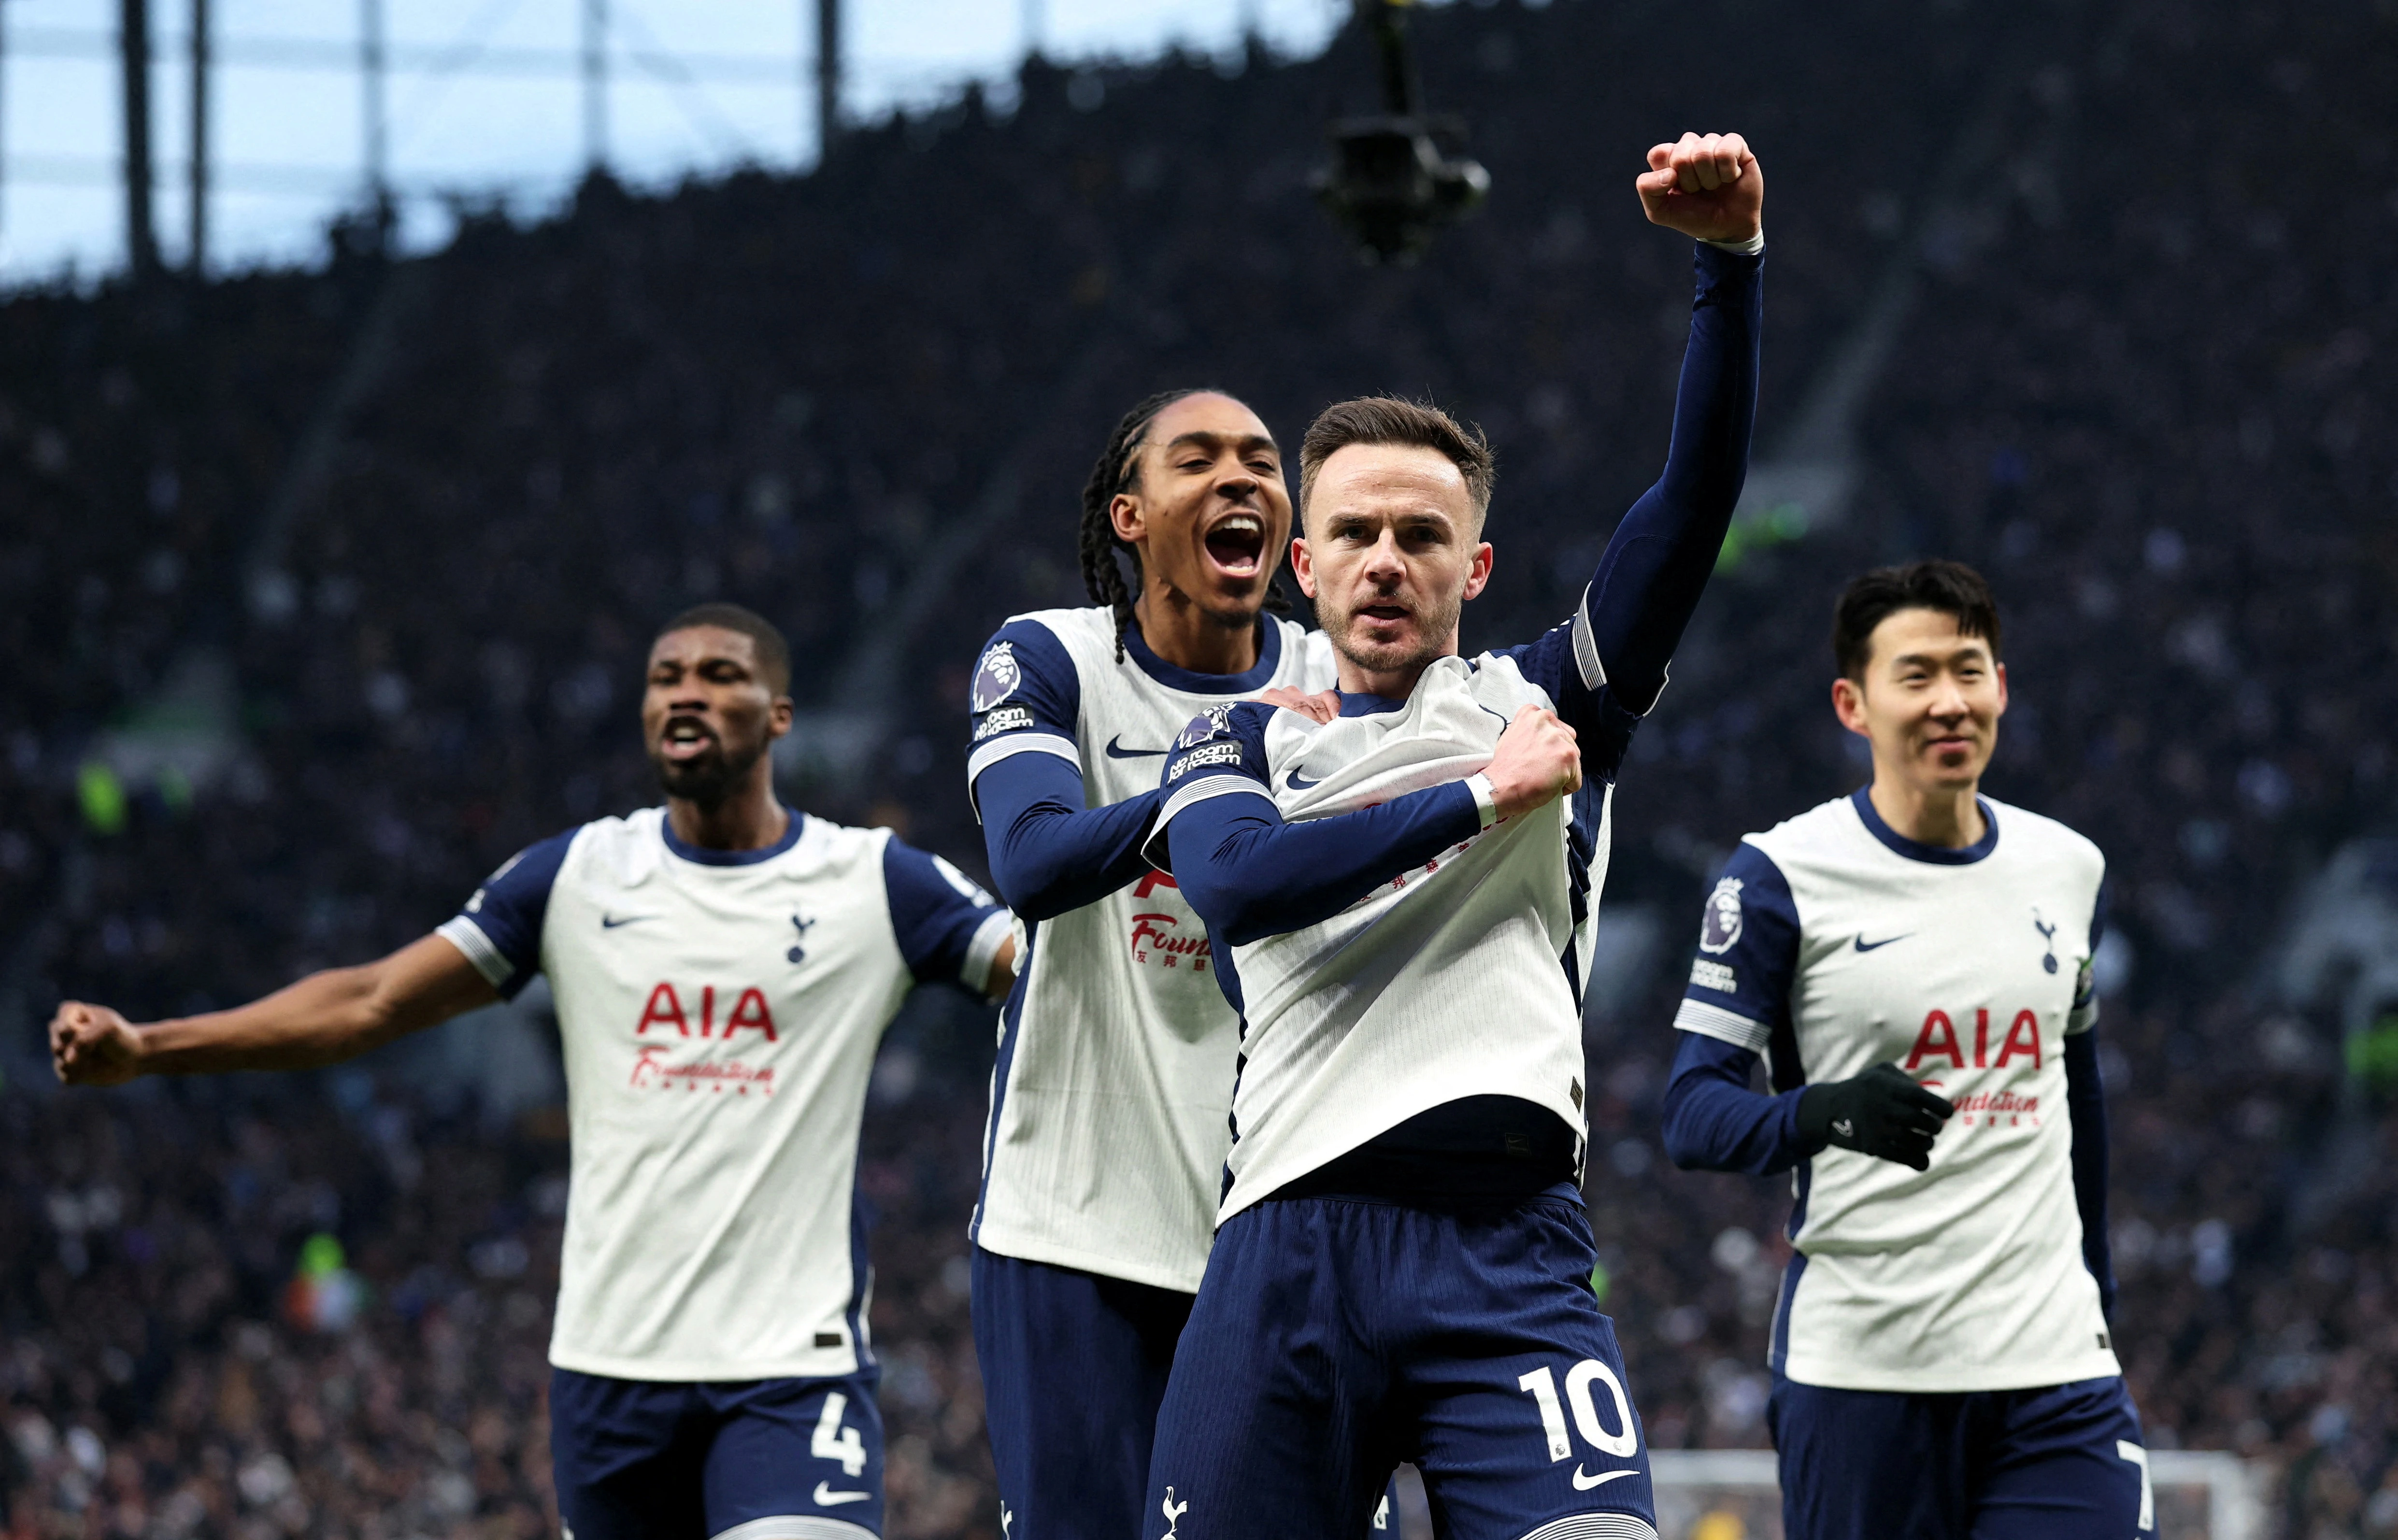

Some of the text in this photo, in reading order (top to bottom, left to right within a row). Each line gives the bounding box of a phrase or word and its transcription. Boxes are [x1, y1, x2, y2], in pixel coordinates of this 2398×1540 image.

[987, 707, 1025, 728] room
[1167, 754, 1241, 784] for racism
[1170, 744, 1233, 773] No room
[635, 982, 778, 1043] AIA
[1905, 1008, 2041, 1070] AIA
[811, 1392, 867, 1478] 4
[1518, 1358, 1638, 1463] 10
[2116, 1439, 2154, 1532] 7
